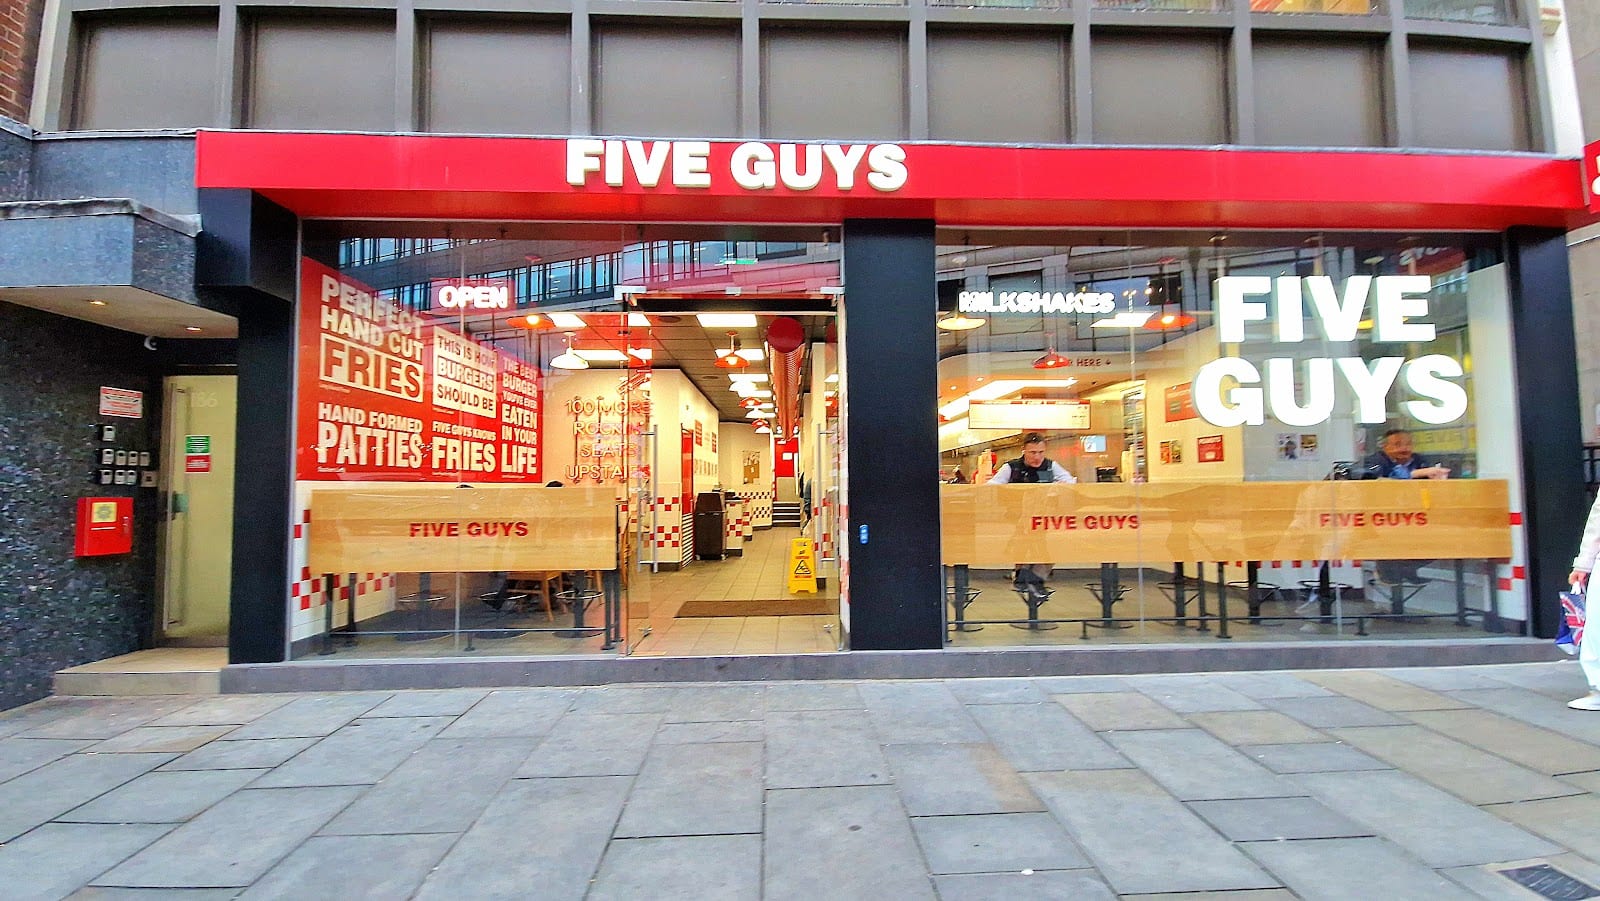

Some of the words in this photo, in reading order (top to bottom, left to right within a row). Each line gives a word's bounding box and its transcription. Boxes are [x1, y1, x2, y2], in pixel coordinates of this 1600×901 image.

[566, 139, 712, 187] FIVE
[730, 141, 908, 192] GUYS
[321, 274, 424, 339] PERFECT
[438, 285, 508, 309] OPEN
[958, 290, 1116, 314] MILKSHAKES
[1214, 275, 1437, 343] FIVE
[321, 304, 384, 346] HAND
[388, 332, 424, 361] CUT
[438, 335, 461, 356] THIS
[463, 345, 472, 361] IS
[324, 337, 421, 398] FRIES
[438, 358, 494, 393] BURGERS
[1077, 358, 1102, 367] HERE
[437, 383, 480, 408] SHOULD
[482, 396, 494, 411] BE
[502, 372, 538, 398] BURGER
[1192, 355, 1468, 427] GUYS
[318, 402, 366, 425] HAND
[369, 410, 423, 433] FORMED
[501, 403, 538, 429] EATEN
[565, 399, 596, 416] 100
[432, 420, 452, 434] FIVE
[501, 425, 513, 440] IN
[514, 427, 537, 445] YOUR
[317, 421, 423, 468] PATTIES
[432, 436, 496, 473] FRIES
[501, 443, 537, 474] LIFE
[409, 522, 459, 537] FIVE
[467, 521, 529, 537] GUYS
[1031, 516, 1077, 530] FIVE
[1084, 515, 1139, 530] GUYS
[1319, 513, 1365, 527] FIVE
[1372, 512, 1428, 527] GUYS
